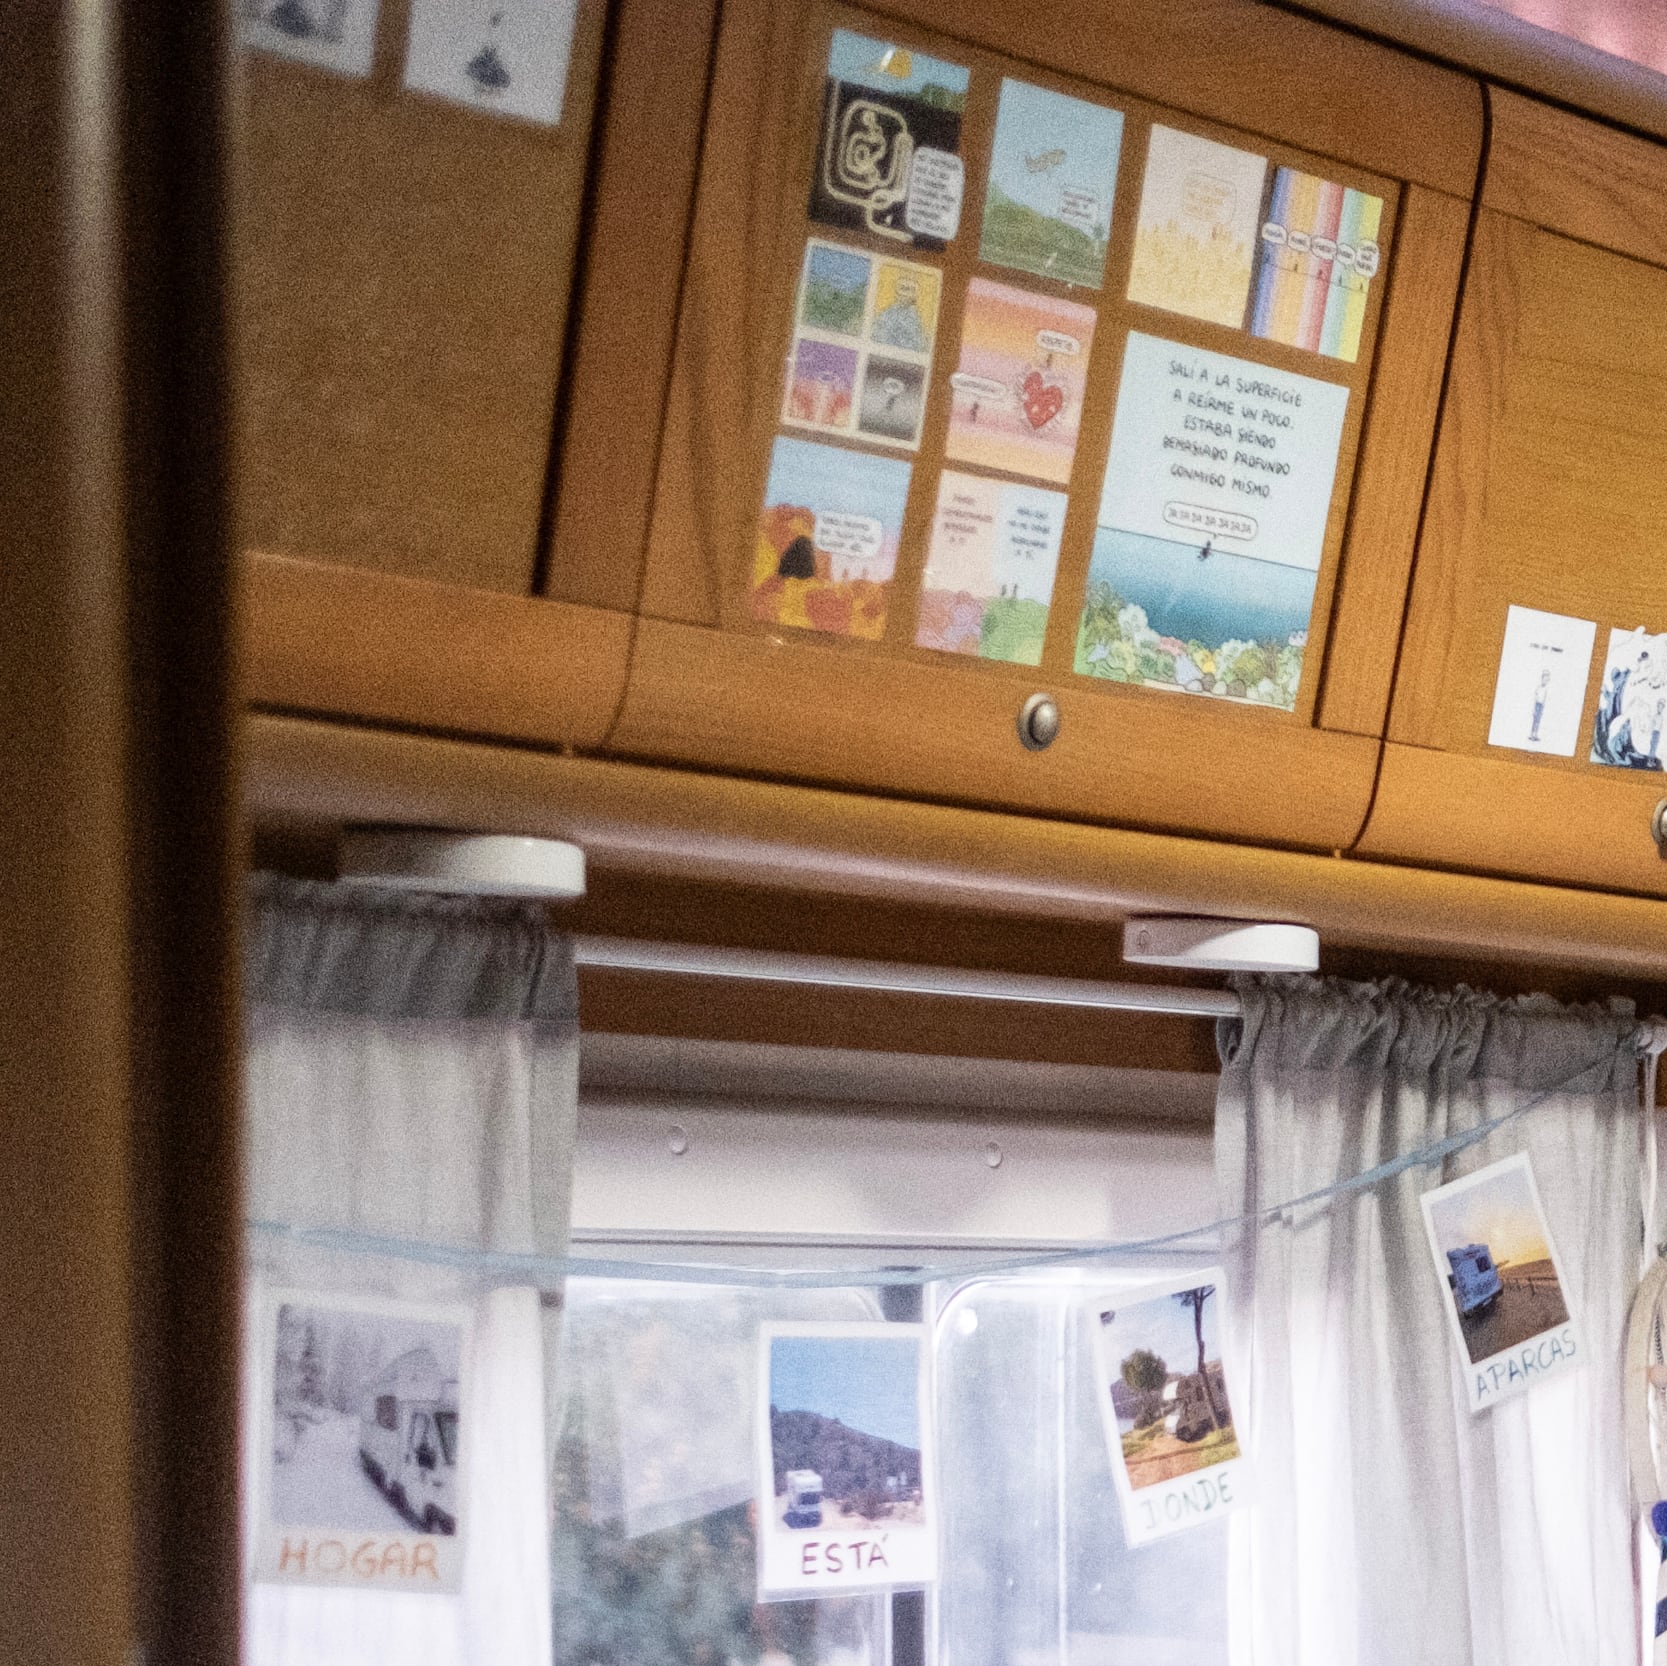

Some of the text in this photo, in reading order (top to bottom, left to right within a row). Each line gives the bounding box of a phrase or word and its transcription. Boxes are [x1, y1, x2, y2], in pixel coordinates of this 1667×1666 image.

[1173, 388, 1182, 401] A
[1241, 405, 1258, 420] UN
[1200, 368, 1208, 381] A
[1215, 374, 1230, 388] LA
[1236, 377, 1302, 408] SUPERFICIE
[1184, 414, 1276, 449] ESTABA SIENDO
[1163, 435, 1290, 475] DEMASIADO PROFUNDO
[1170, 462, 1225, 488] CONMIGO
[1476, 1328, 1576, 1401] APARCAS
[278, 1536, 439, 1581] HOGAR
[802, 1533, 888, 1575] ESTÁ
